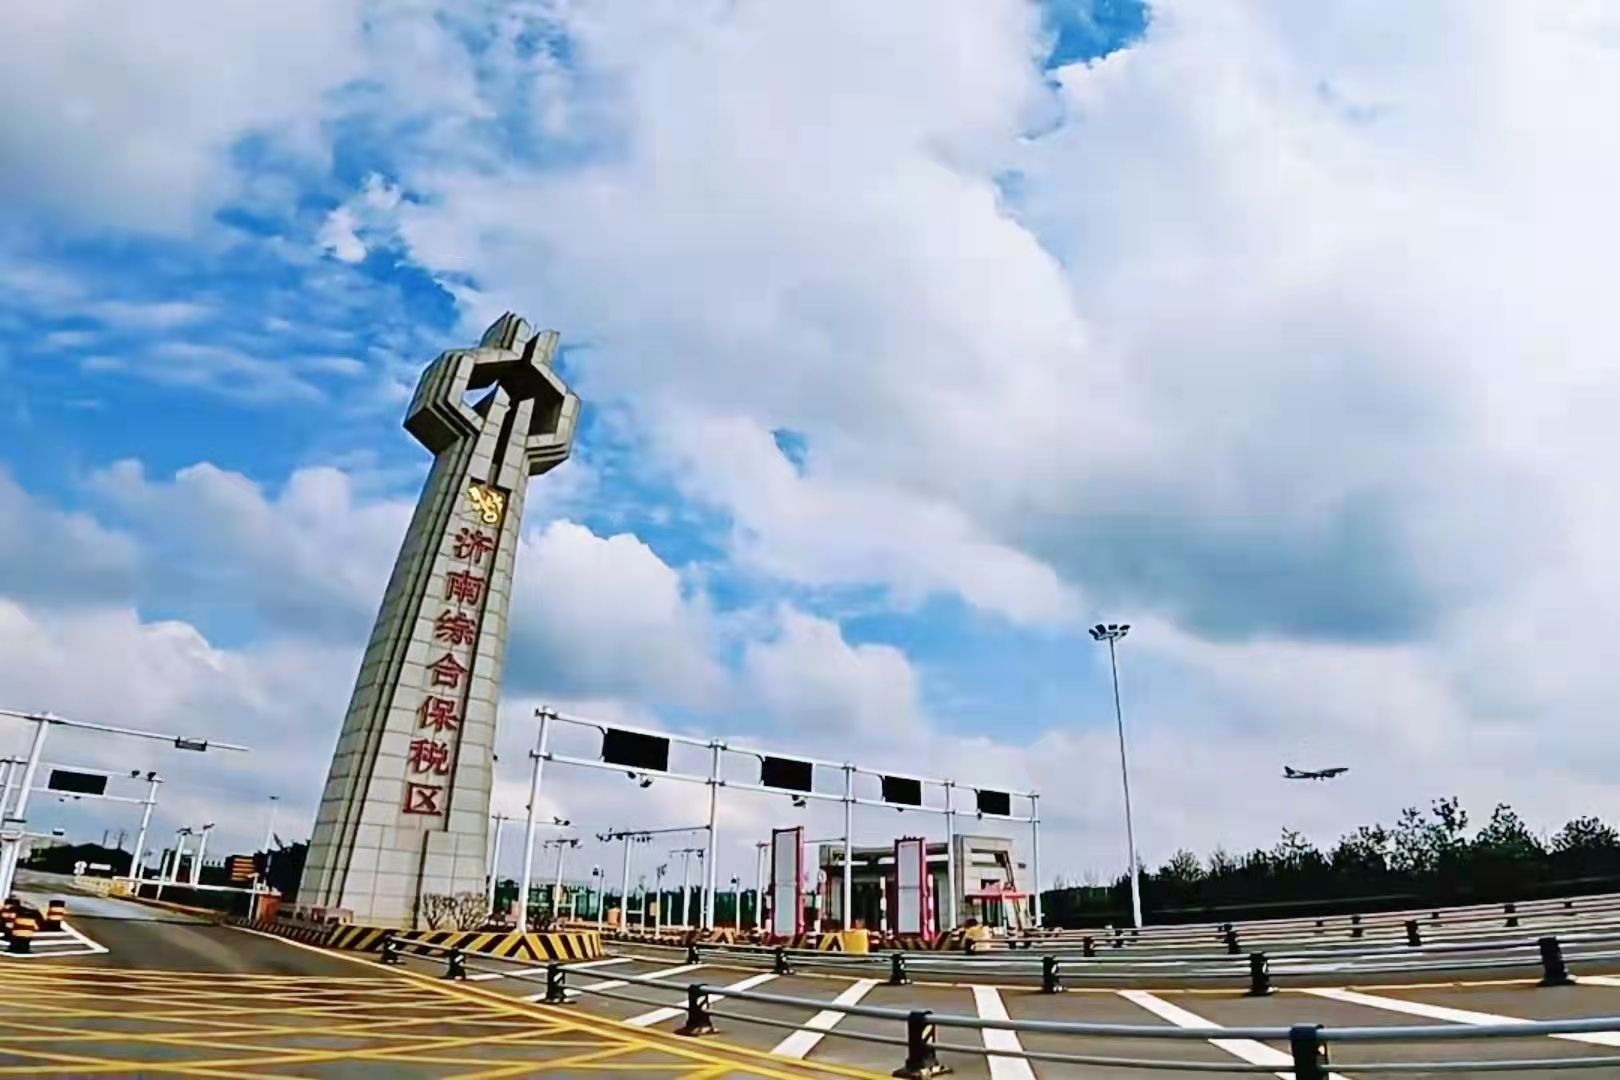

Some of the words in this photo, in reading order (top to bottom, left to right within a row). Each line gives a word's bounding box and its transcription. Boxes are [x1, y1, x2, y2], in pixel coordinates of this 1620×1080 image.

[402, 527, 494, 816] 济南综合保税区
